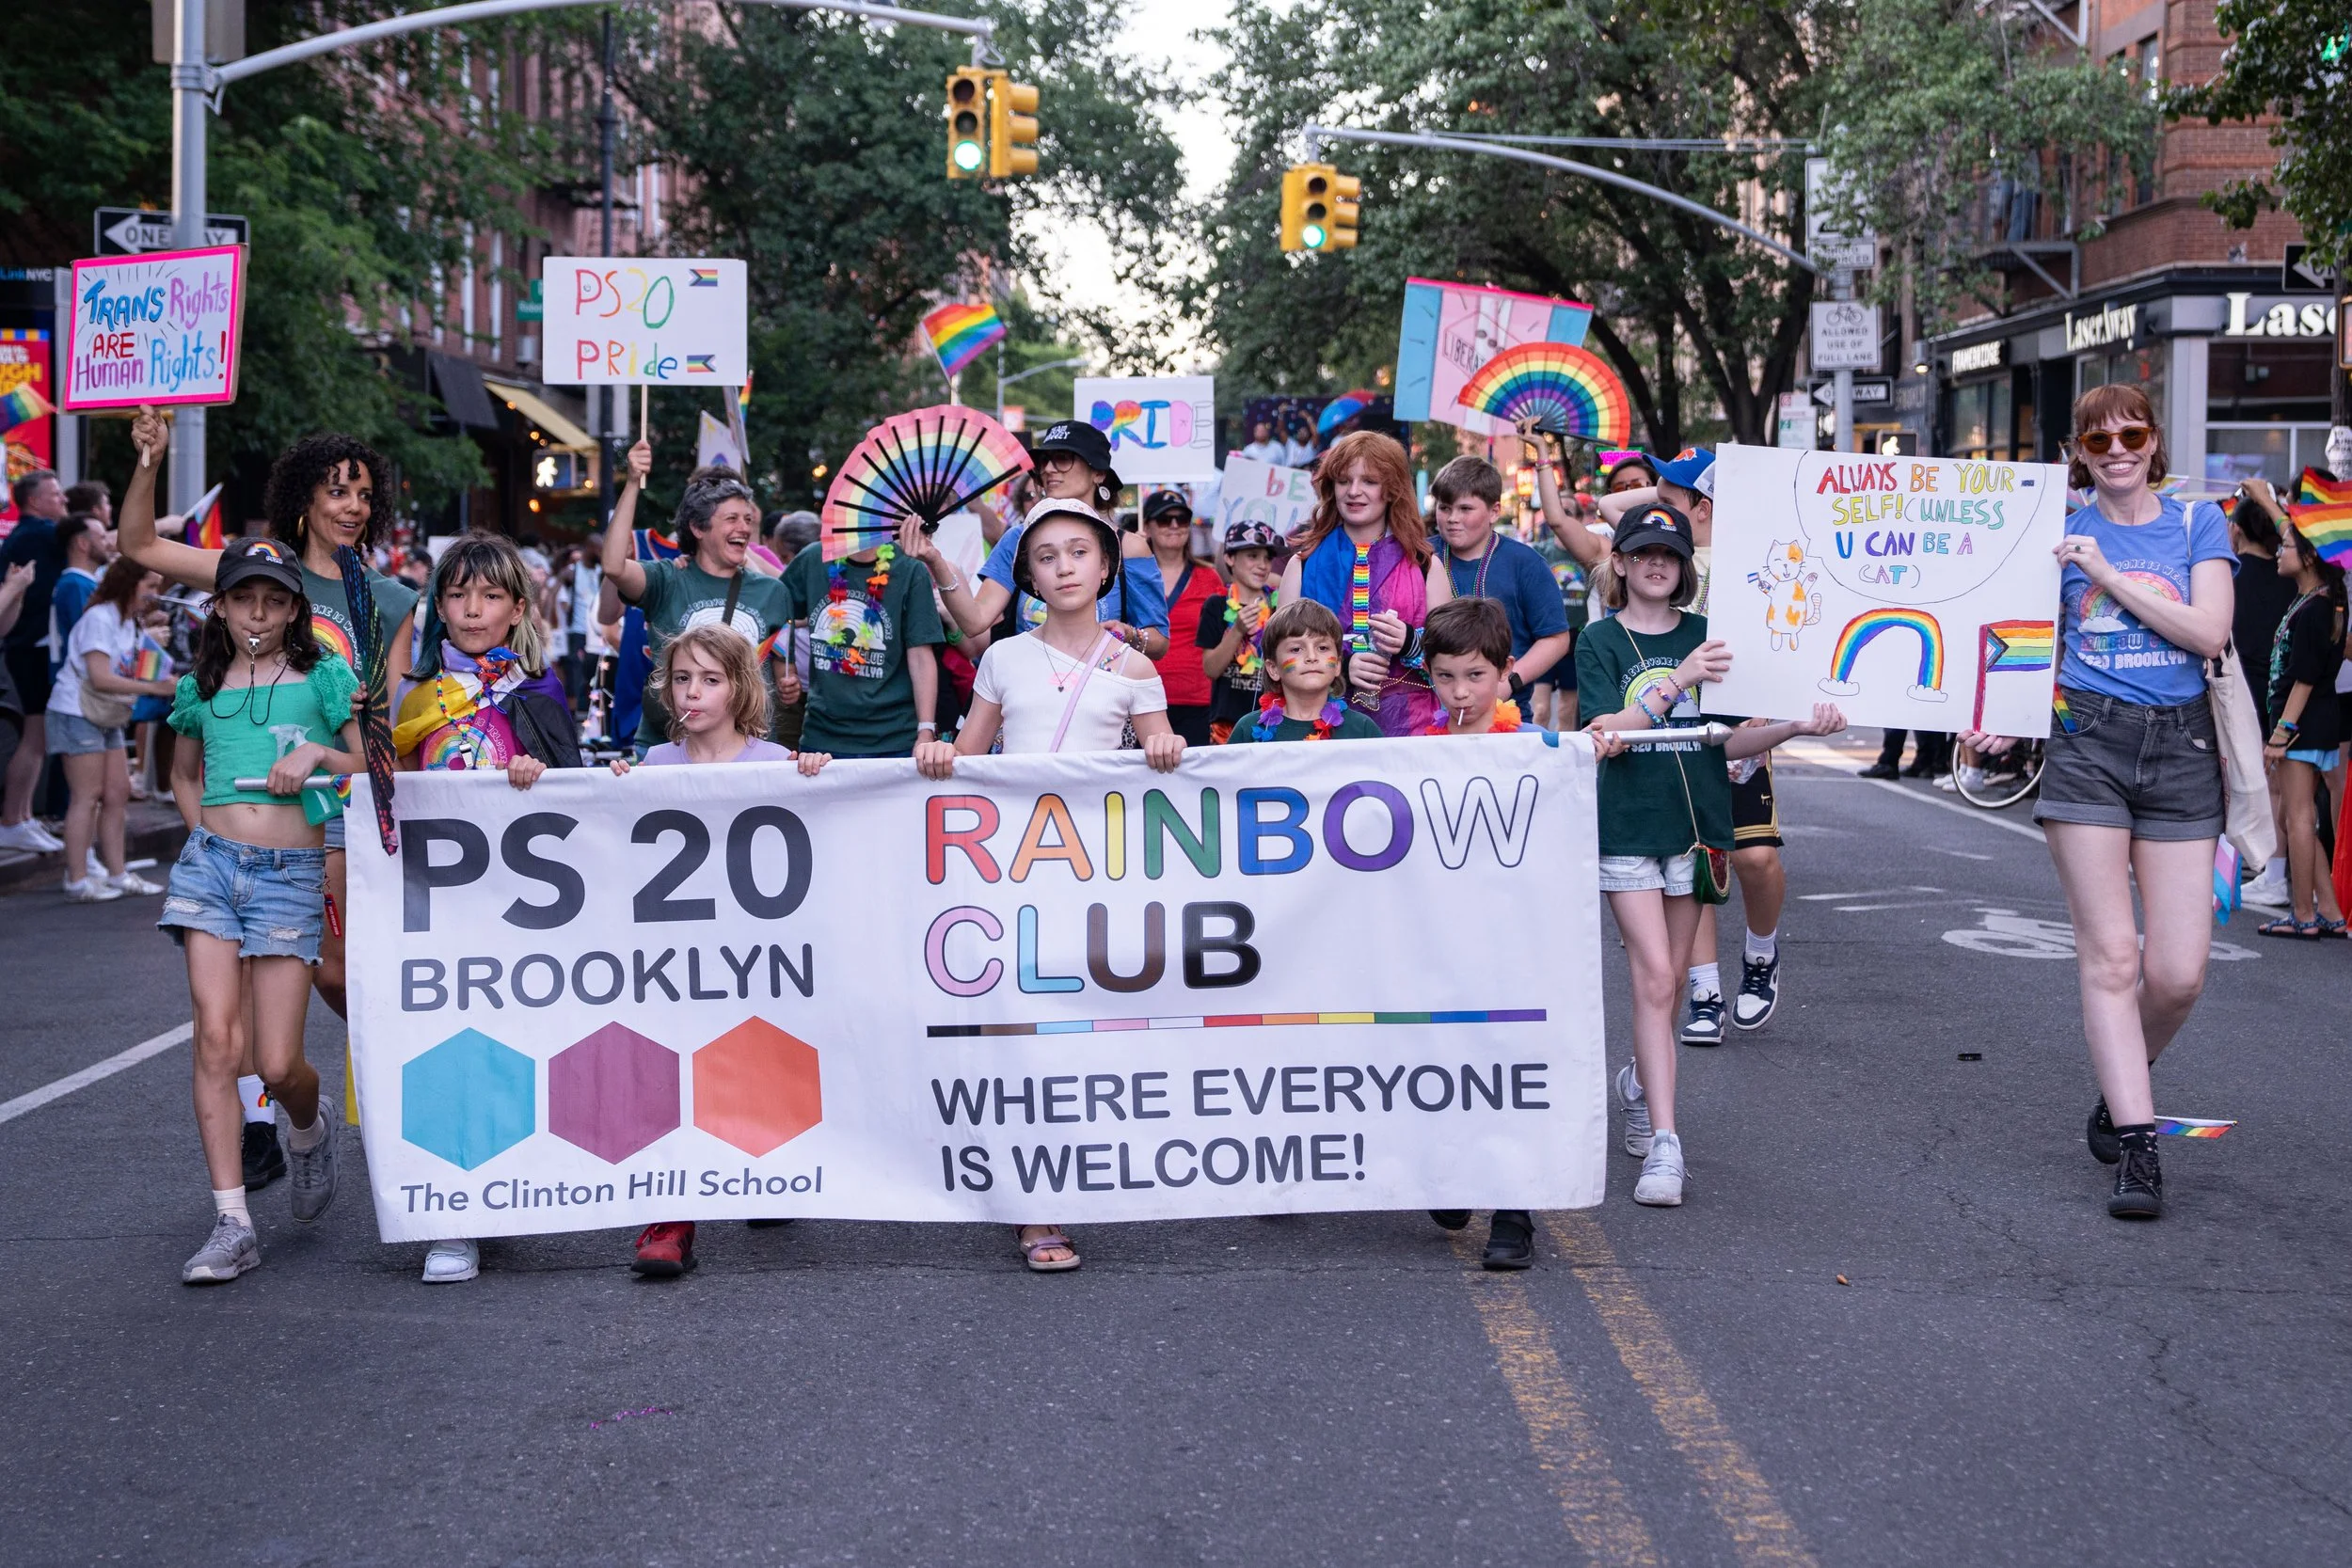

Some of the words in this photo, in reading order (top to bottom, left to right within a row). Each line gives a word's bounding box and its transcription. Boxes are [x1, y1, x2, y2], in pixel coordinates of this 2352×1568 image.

[125, 226, 170, 245] ONE
[83, 278, 166, 331] TRANS
[169, 271, 229, 329] Rights
[575, 267, 675, 328] PS20
[92, 332, 135, 359] ARE
[1827, 341, 1846, 349] USE
[2065, 301, 2138, 351] LaserAway
[1847, 353, 1873, 361] LANE
[1854, 387, 1880, 397] WAY
[1090, 400, 1213, 451] PRIDE
[1910, 464, 1939, 493] BE
[1832, 493, 1903, 526] SELF!
[1836, 531, 1853, 560] U
[1865, 531, 1915, 557] CAN
[1923, 532, 1950, 554] BE
[1957, 532, 1973, 555] A
[332, 610, 345, 624] IS
[2115, 651, 2187, 670] BROOKLYN
[925, 774, 1539, 885] RAINBOW
[399, 812, 585, 933] PS
[630, 805, 813, 923] 20
[924, 899, 1262, 997] CLUB
[401, 943, 814, 1012] BROOKLYN
[930, 1070, 1171, 1127] WHERE
[1192, 1063, 1550, 1117] EVERYONE
[942, 1145, 993, 1193] IS
[1011, 1132, 1366, 1194] WELCOME!
[401, 1182, 469, 1212] The
[482, 1178, 614, 1211] Clinton
[628, 1169, 685, 1200] Hill
[699, 1165, 822, 1197] School
